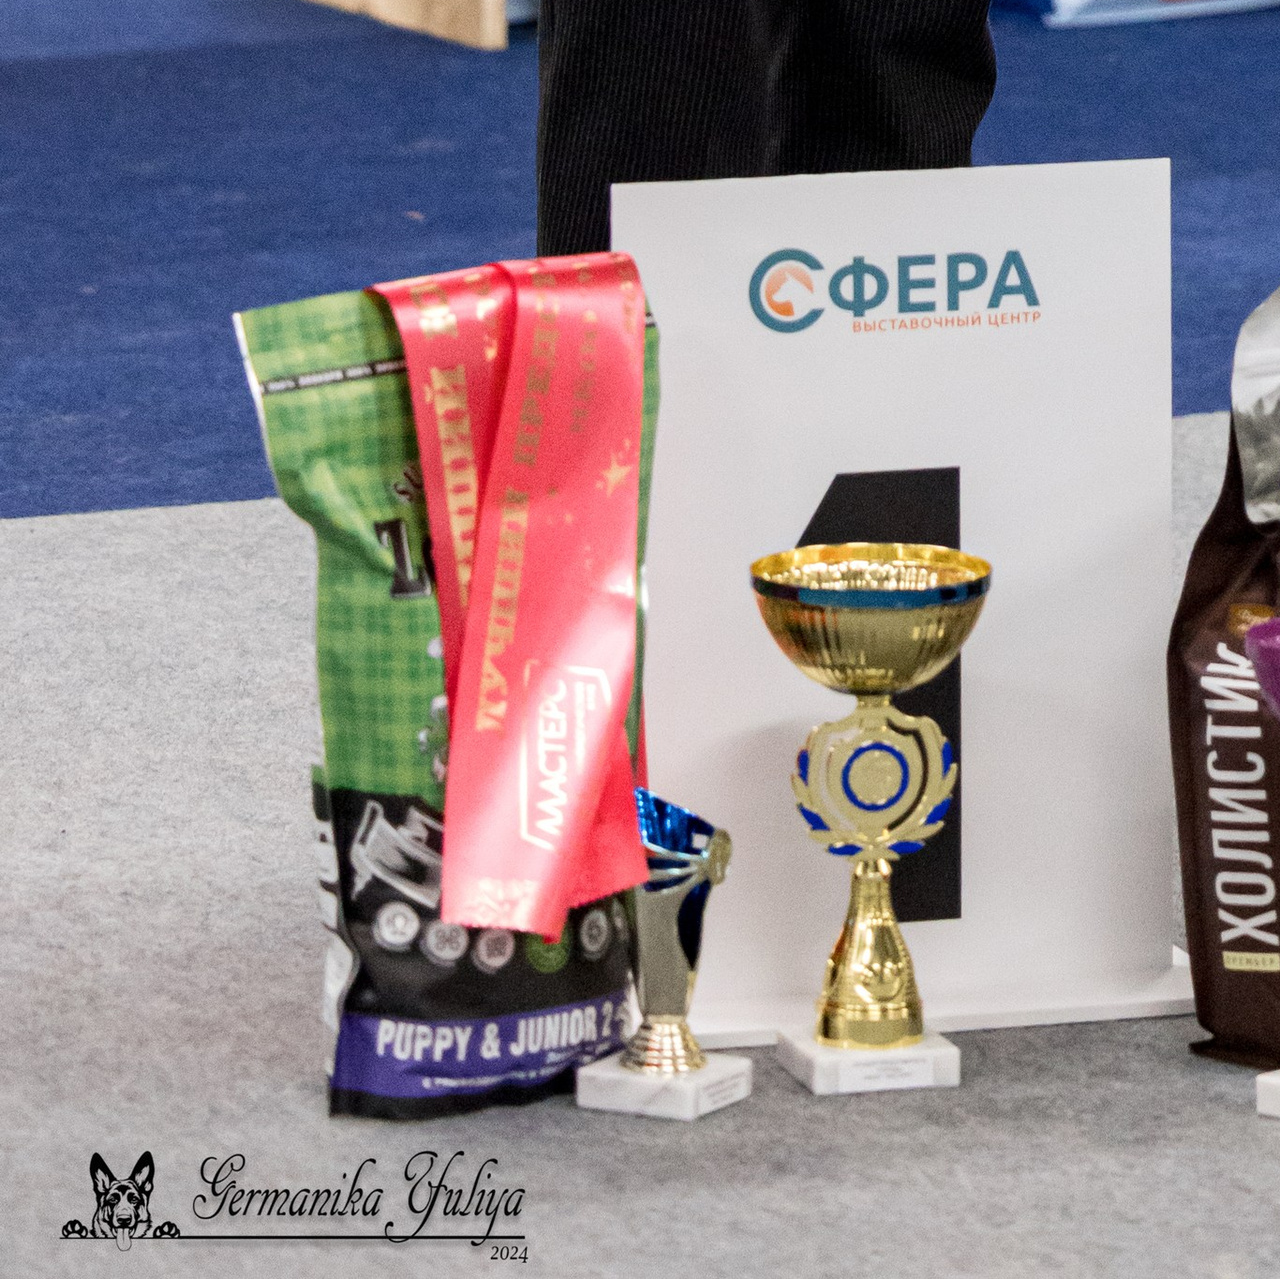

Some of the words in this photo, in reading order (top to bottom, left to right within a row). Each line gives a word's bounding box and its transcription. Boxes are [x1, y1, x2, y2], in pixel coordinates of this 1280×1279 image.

[749, 248, 1041, 333] СФЕРА
[852, 310, 982, 333] ВЫСТАВОЧНЫЙ
[987, 310, 1041, 328] ЦЕНТР
[796, 466, 961, 922] 1
[376, 1019, 473, 1062] PUPPY
[480, 1023, 500, 1059] &
[509, 1005, 598, 1057] JUNIOR
